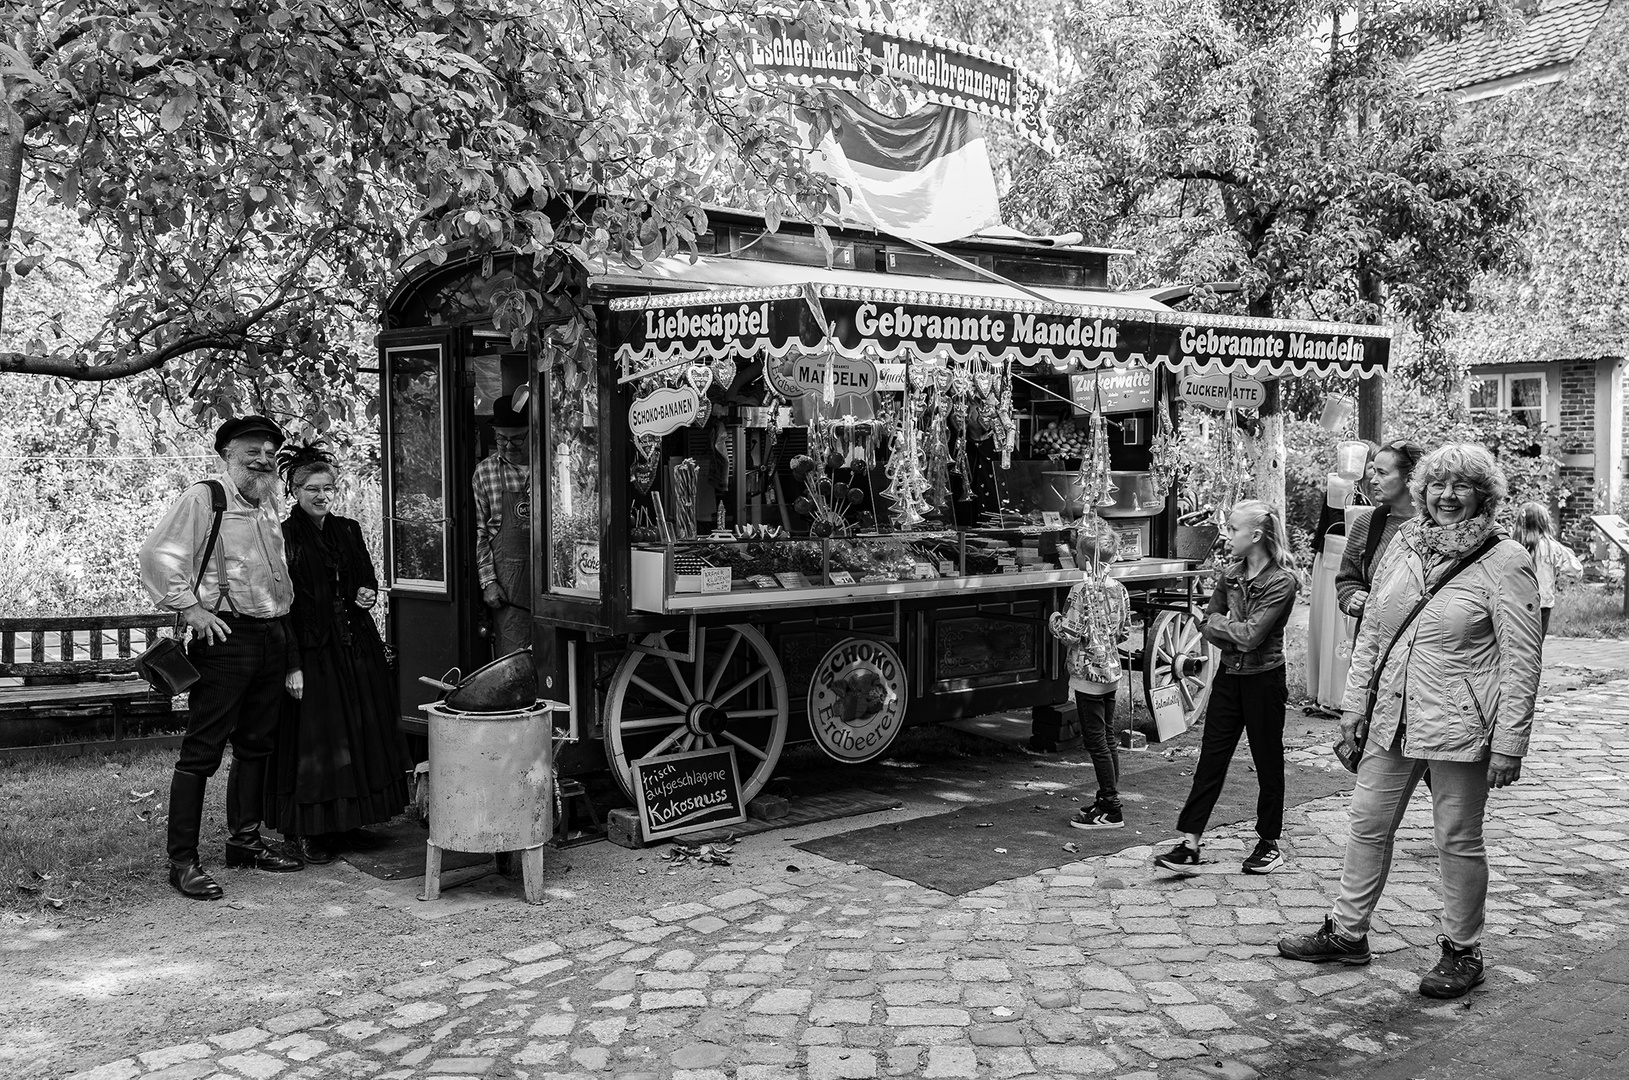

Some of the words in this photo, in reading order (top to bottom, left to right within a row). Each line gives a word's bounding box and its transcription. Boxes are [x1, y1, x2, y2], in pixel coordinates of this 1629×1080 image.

[882, 41, 1011, 105] Mandelbrennerei
[645, 303, 769, 343] Liebesäpfel
[855, 302, 1005, 343] Gebrannte
[1011, 313, 1118, 348] Mandeln
[1180, 327, 1284, 358] Gebrannte
[1288, 333, 1365, 361] Mandeln
[1186, 381, 1258, 400] ZUCKERWATTE
[632, 398, 693, 427] SCHOKO-BANANEN
[820, 644, 896, 689] SCHOKO
[818, 698, 898, 750] Erdbeeren
[642, 764, 677, 790] frisch
[645, 769, 726, 801] aufgeschlagene
[647, 789, 728, 826] Kokosnuss
